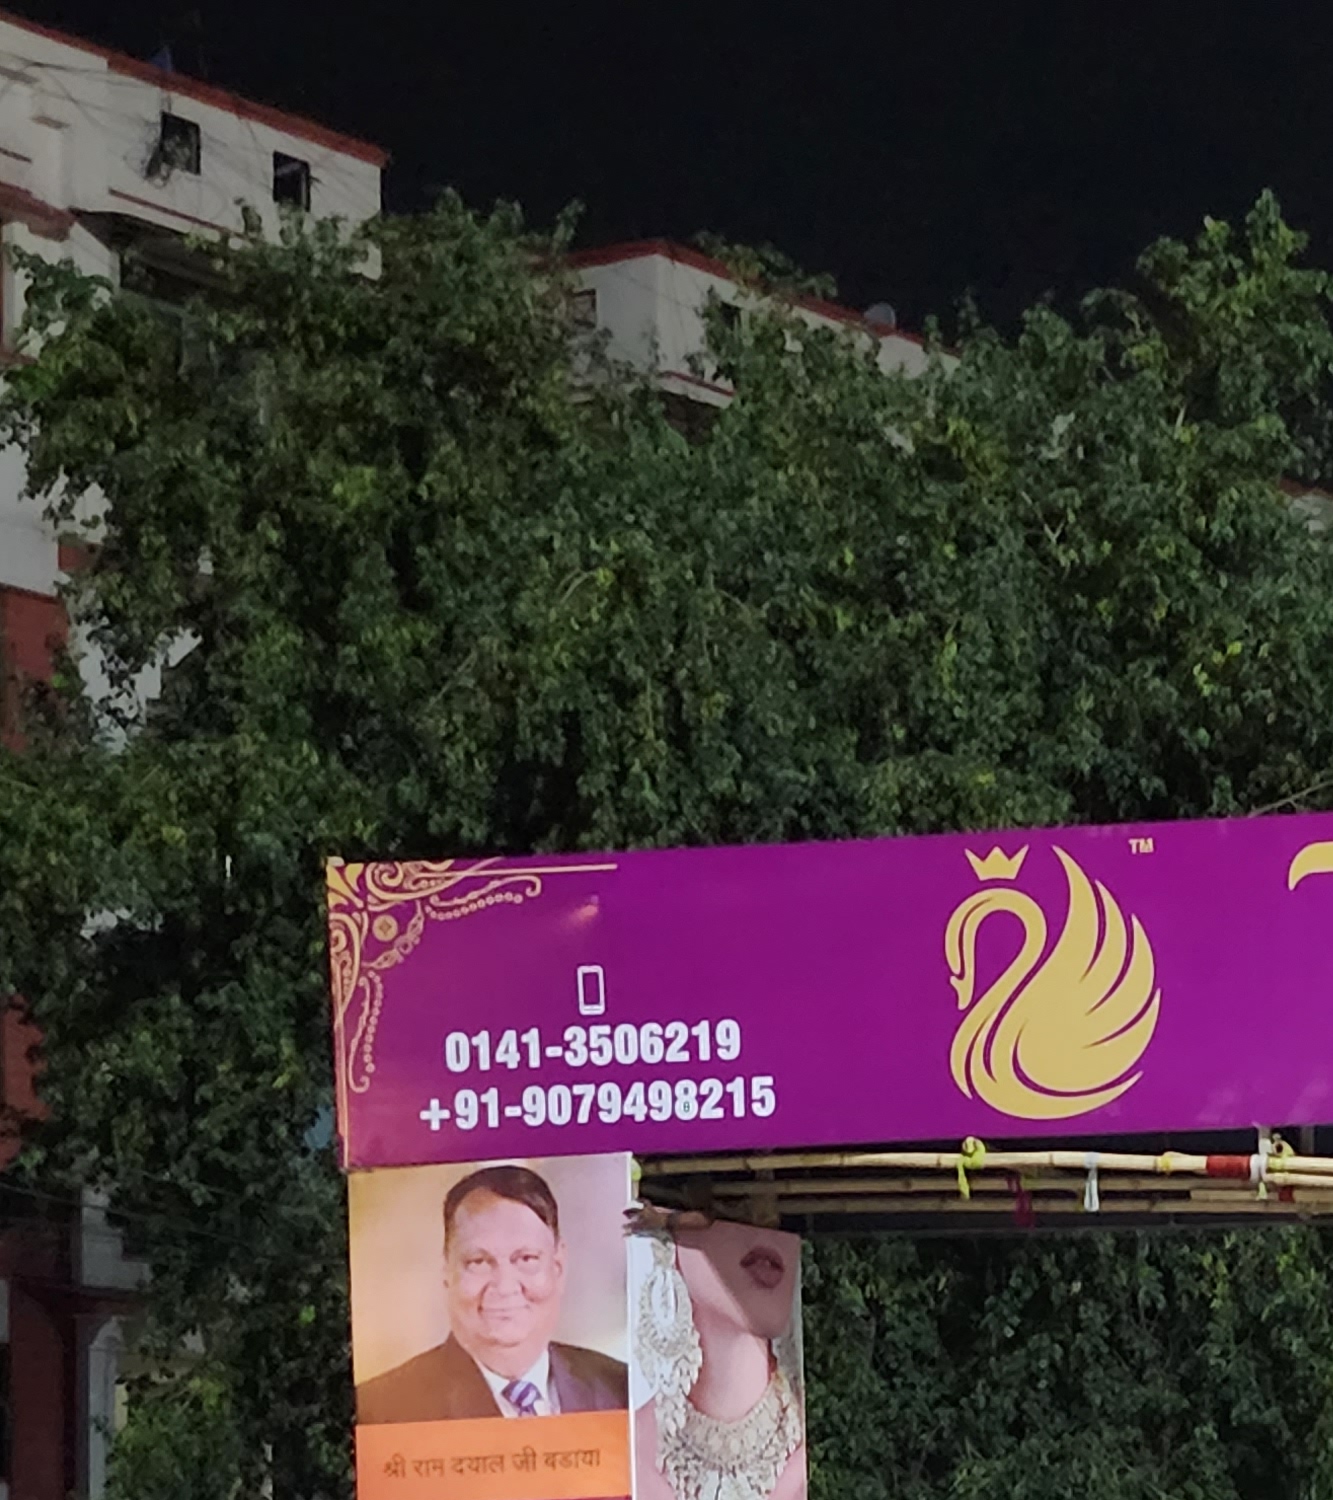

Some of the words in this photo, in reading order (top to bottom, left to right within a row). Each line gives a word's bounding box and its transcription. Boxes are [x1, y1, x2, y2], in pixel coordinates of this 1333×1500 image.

[1128, 837, 1155, 855] TM
[445, 1018, 742, 1074] 0141-3506219
[419, 1075, 777, 1131] +91-9079498215
[383, 1452, 407, 1479] श्री
[411, 1457, 445, 1478] राम
[450, 1453, 506, 1476] दयाल
[511, 1445, 538, 1473] जी
